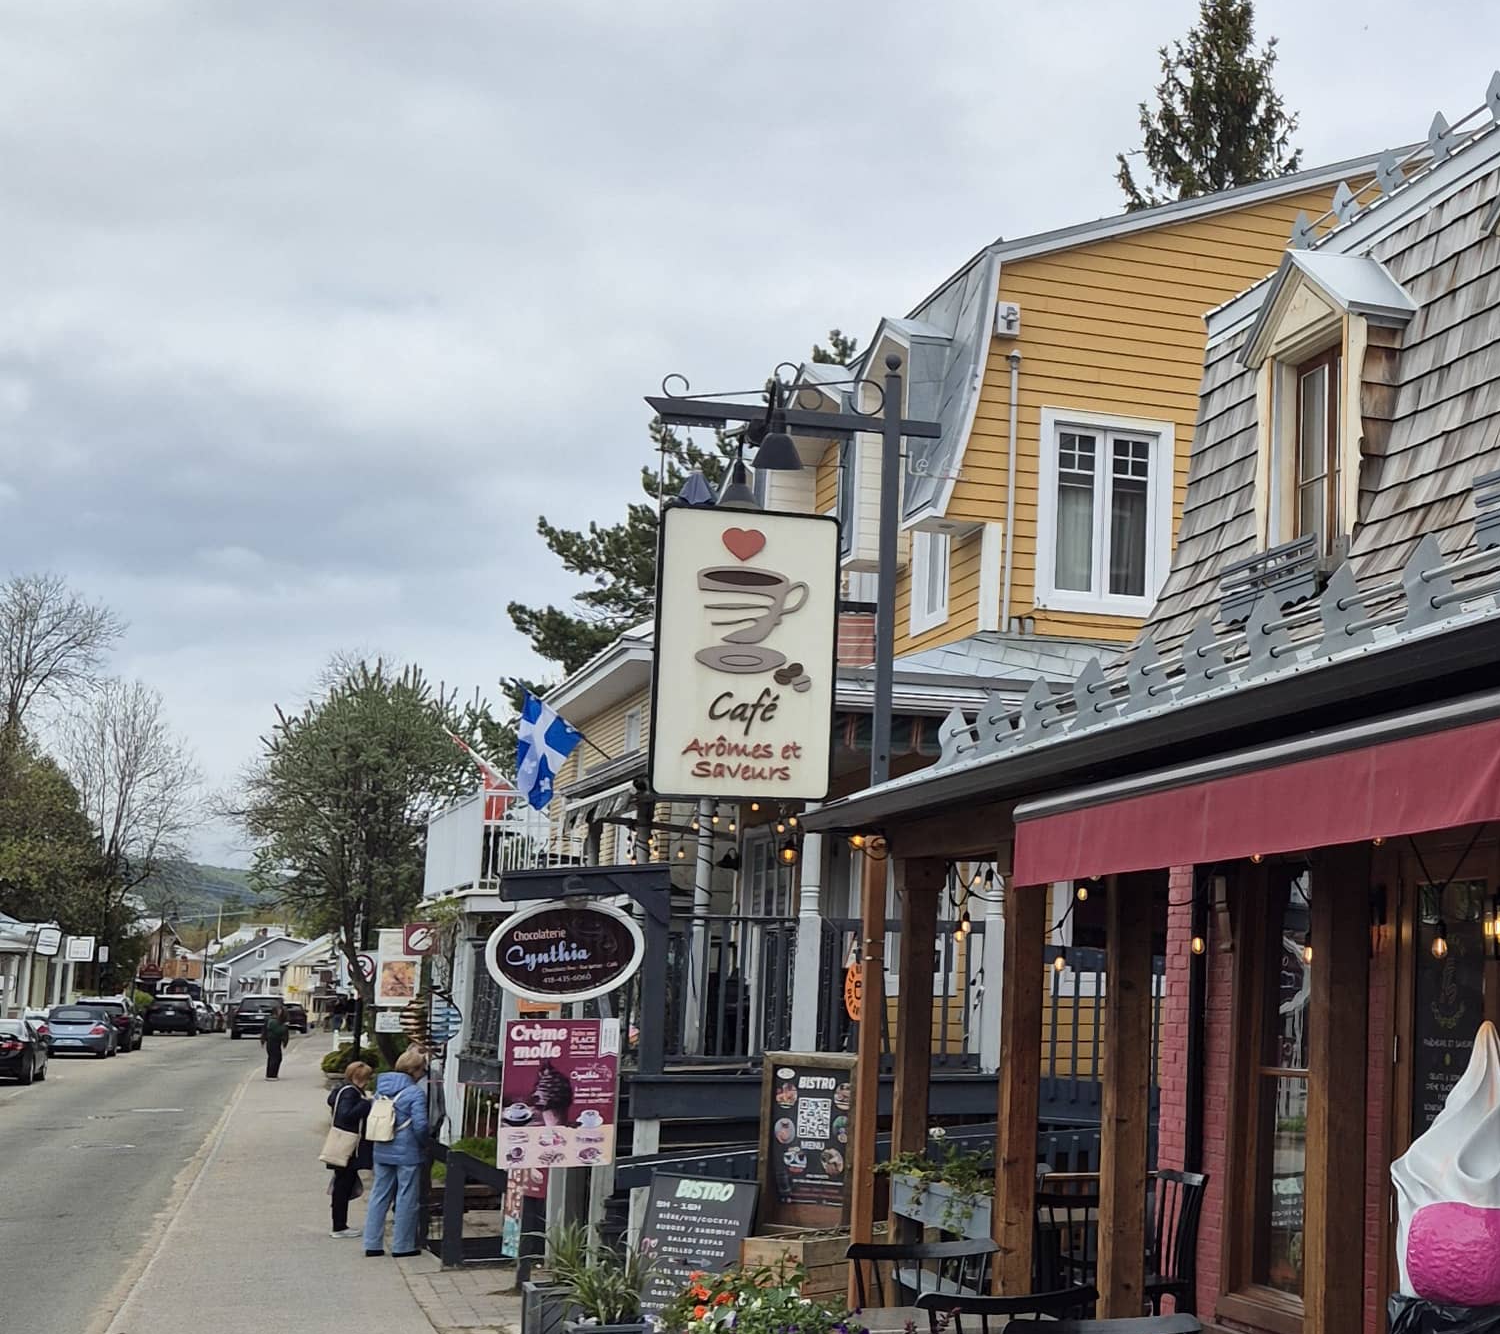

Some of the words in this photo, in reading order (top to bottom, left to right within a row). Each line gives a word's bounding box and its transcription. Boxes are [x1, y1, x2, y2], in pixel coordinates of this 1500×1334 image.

[709, 687, 780, 736] Café
[682, 735, 774, 758] Arômes
[781, 742, 802, 759] et
[691, 761, 792, 781] Saveurs
[513, 928, 567, 942] Chocolaterie
[506, 940, 592, 971] Cynthia
[511, 1024, 568, 1041] Crème
[513, 1042, 561, 1059] molle
[798, 1077, 836, 1090] BISTRO
[800, 1141, 825, 1151] MENU
[675, 1179, 735, 1202] BISTRO
[667, 1235, 697, 1244] SALADE
[695, 1228, 736, 1236] SANDWICH
[662, 1246, 693, 1255] GRILLED
[695, 1249, 725, 1257] CHEESE
